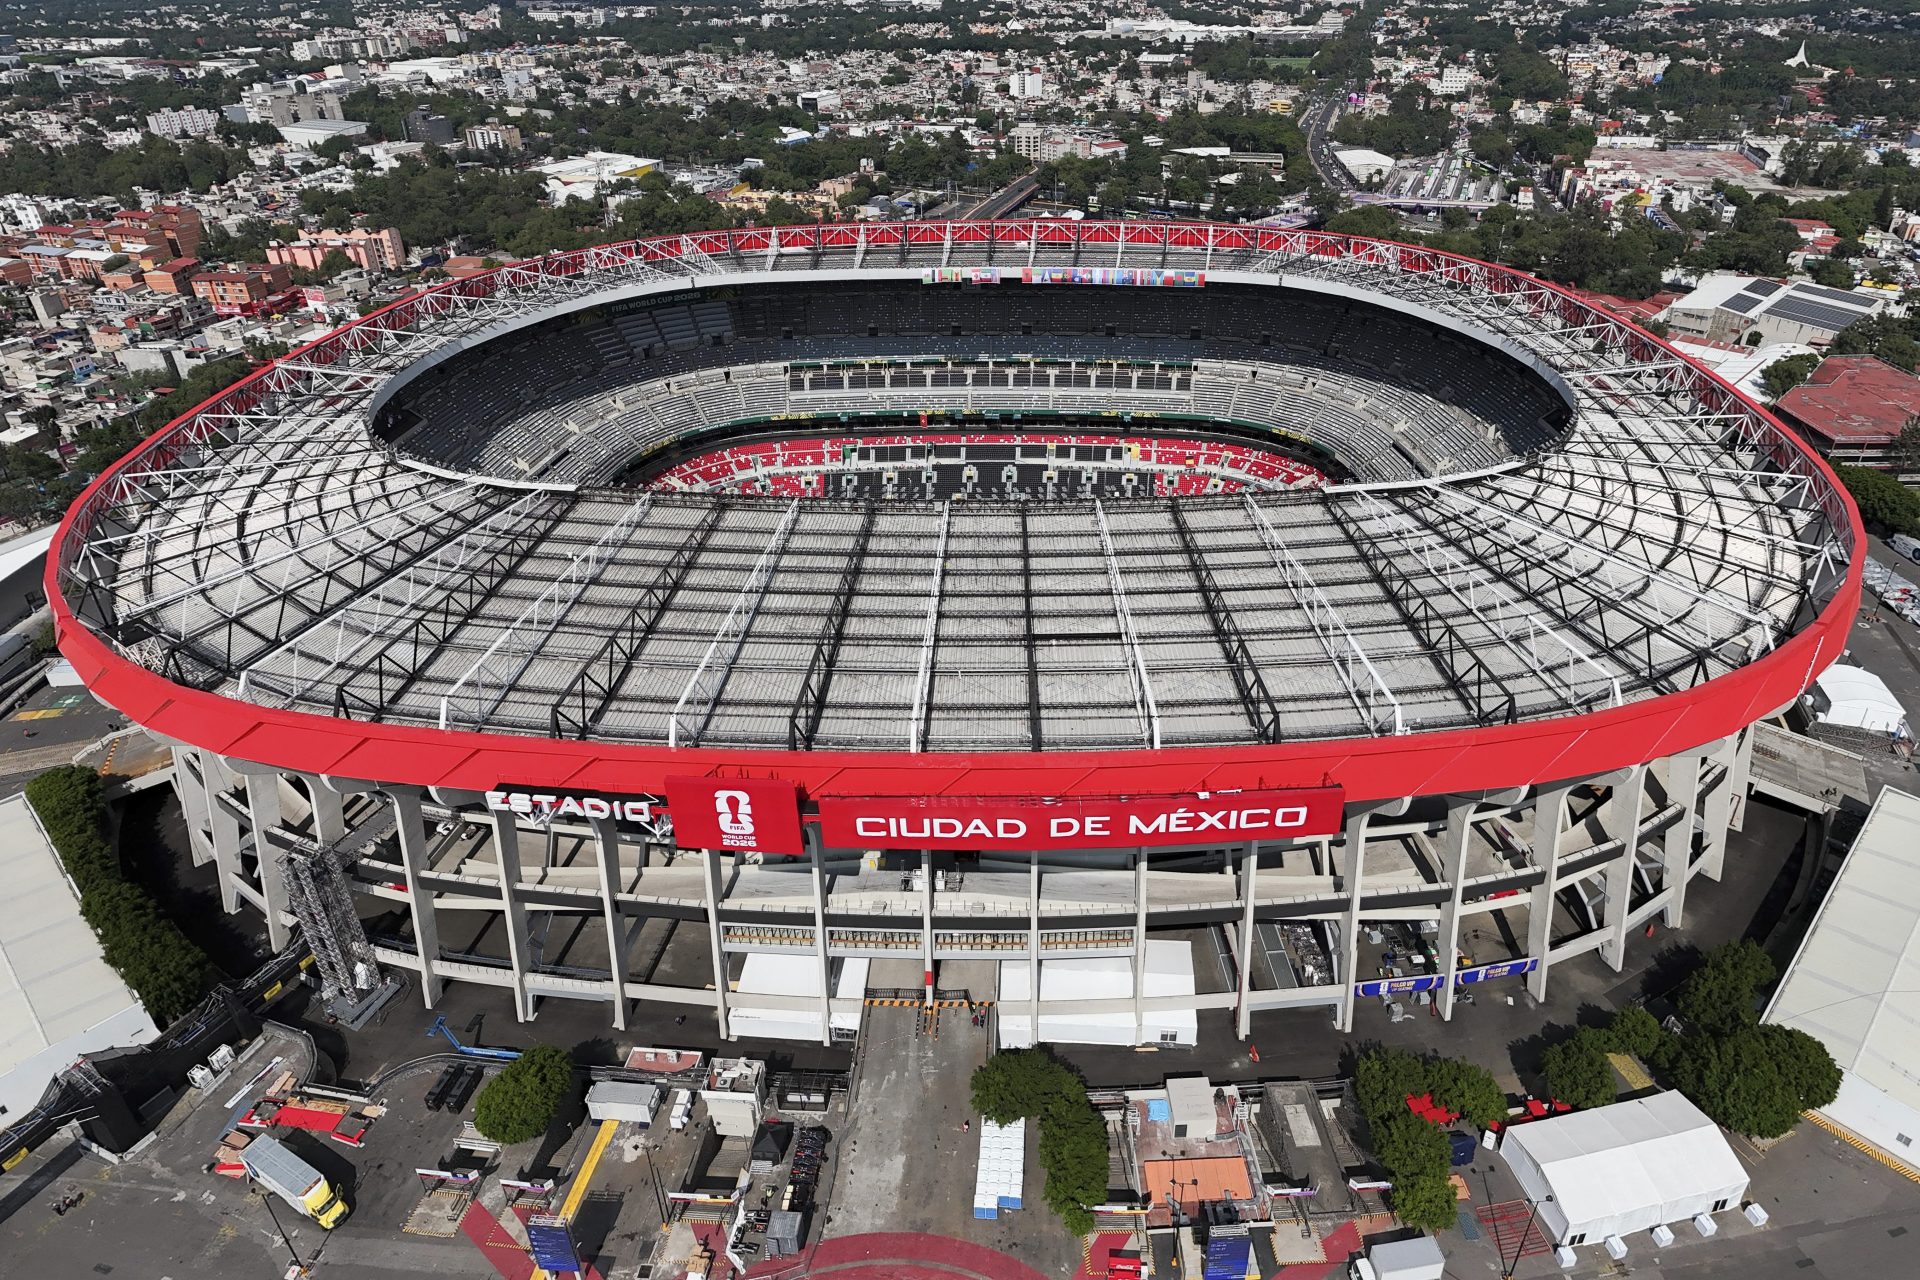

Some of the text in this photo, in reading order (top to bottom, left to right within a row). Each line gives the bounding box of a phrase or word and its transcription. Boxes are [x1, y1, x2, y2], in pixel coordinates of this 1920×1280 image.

[611, 291, 701, 312] FIFA WORLD CUP 2026
[484, 790, 652, 823] ESTADIO
[855, 807, 1308, 839] CIUDAD DE MÉXICO
[722, 839, 757, 847] 2026
